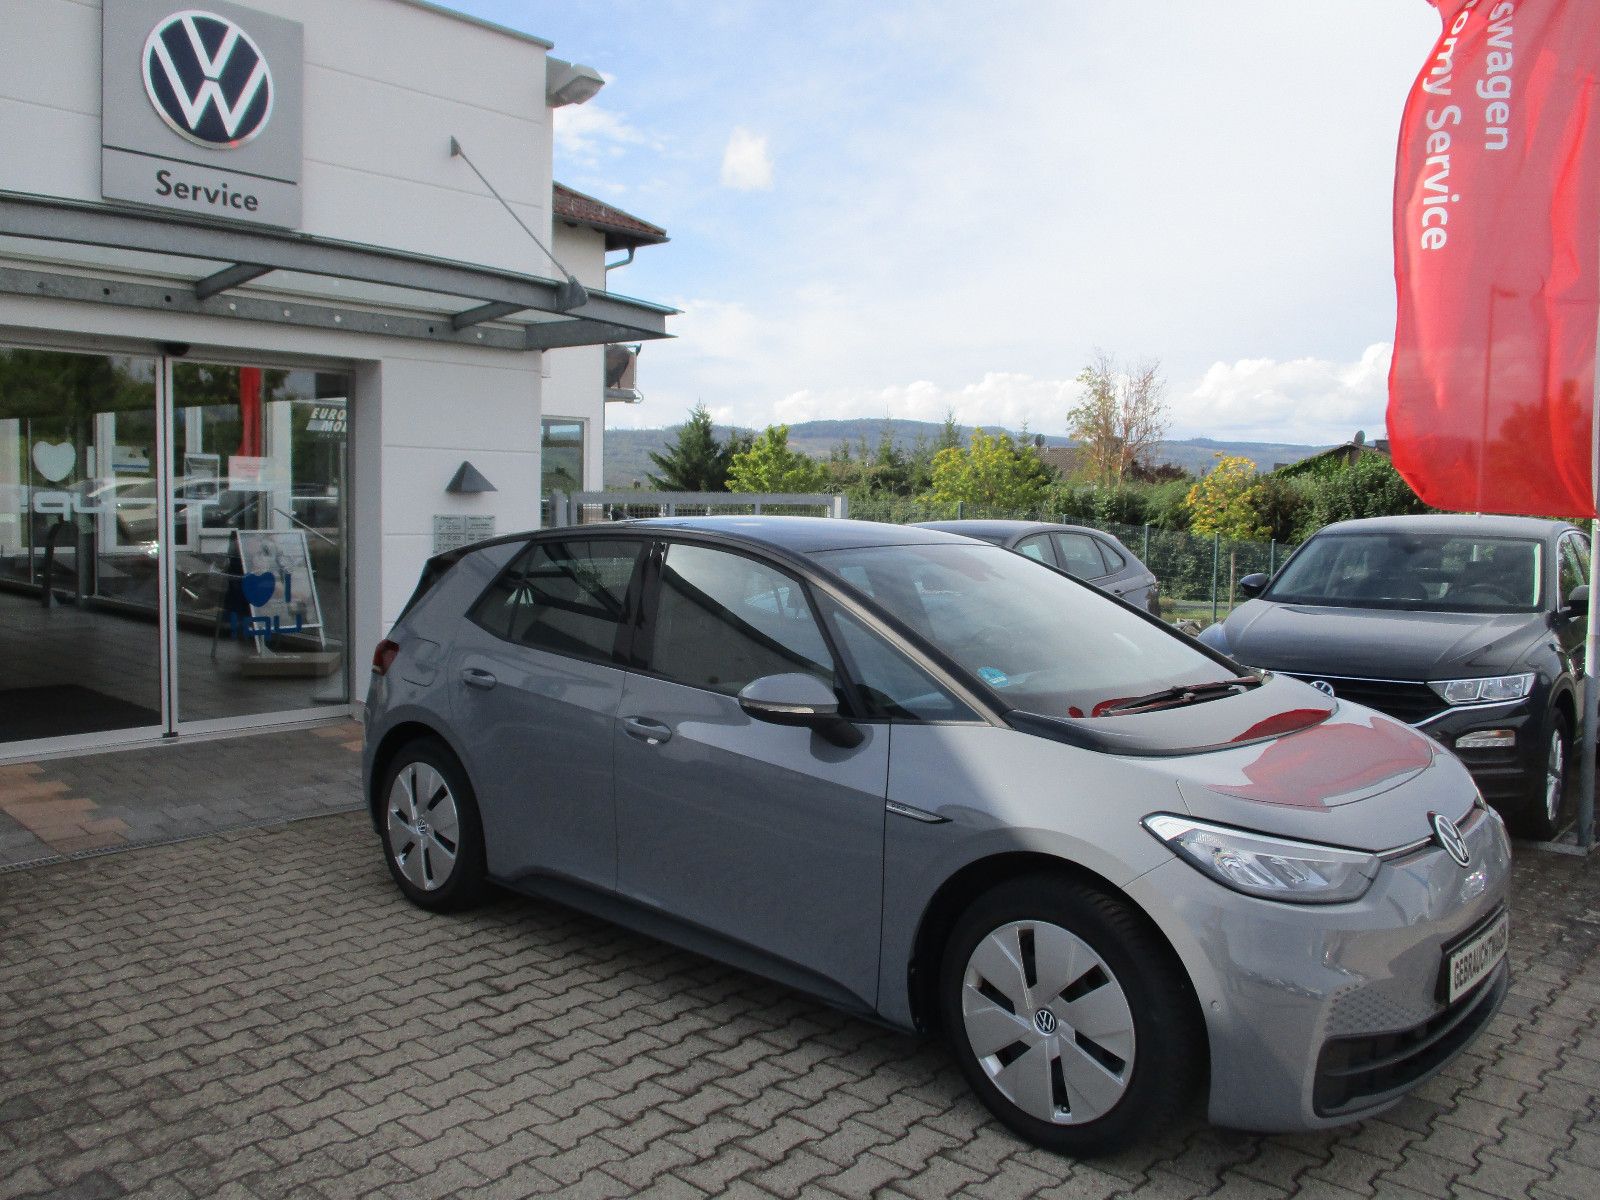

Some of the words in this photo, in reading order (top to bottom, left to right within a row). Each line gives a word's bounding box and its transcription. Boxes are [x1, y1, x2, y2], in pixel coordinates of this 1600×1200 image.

[156, 169, 259, 211] Service
[1421, 105, 1462, 250] Service
[310, 407, 347, 420] EURO
